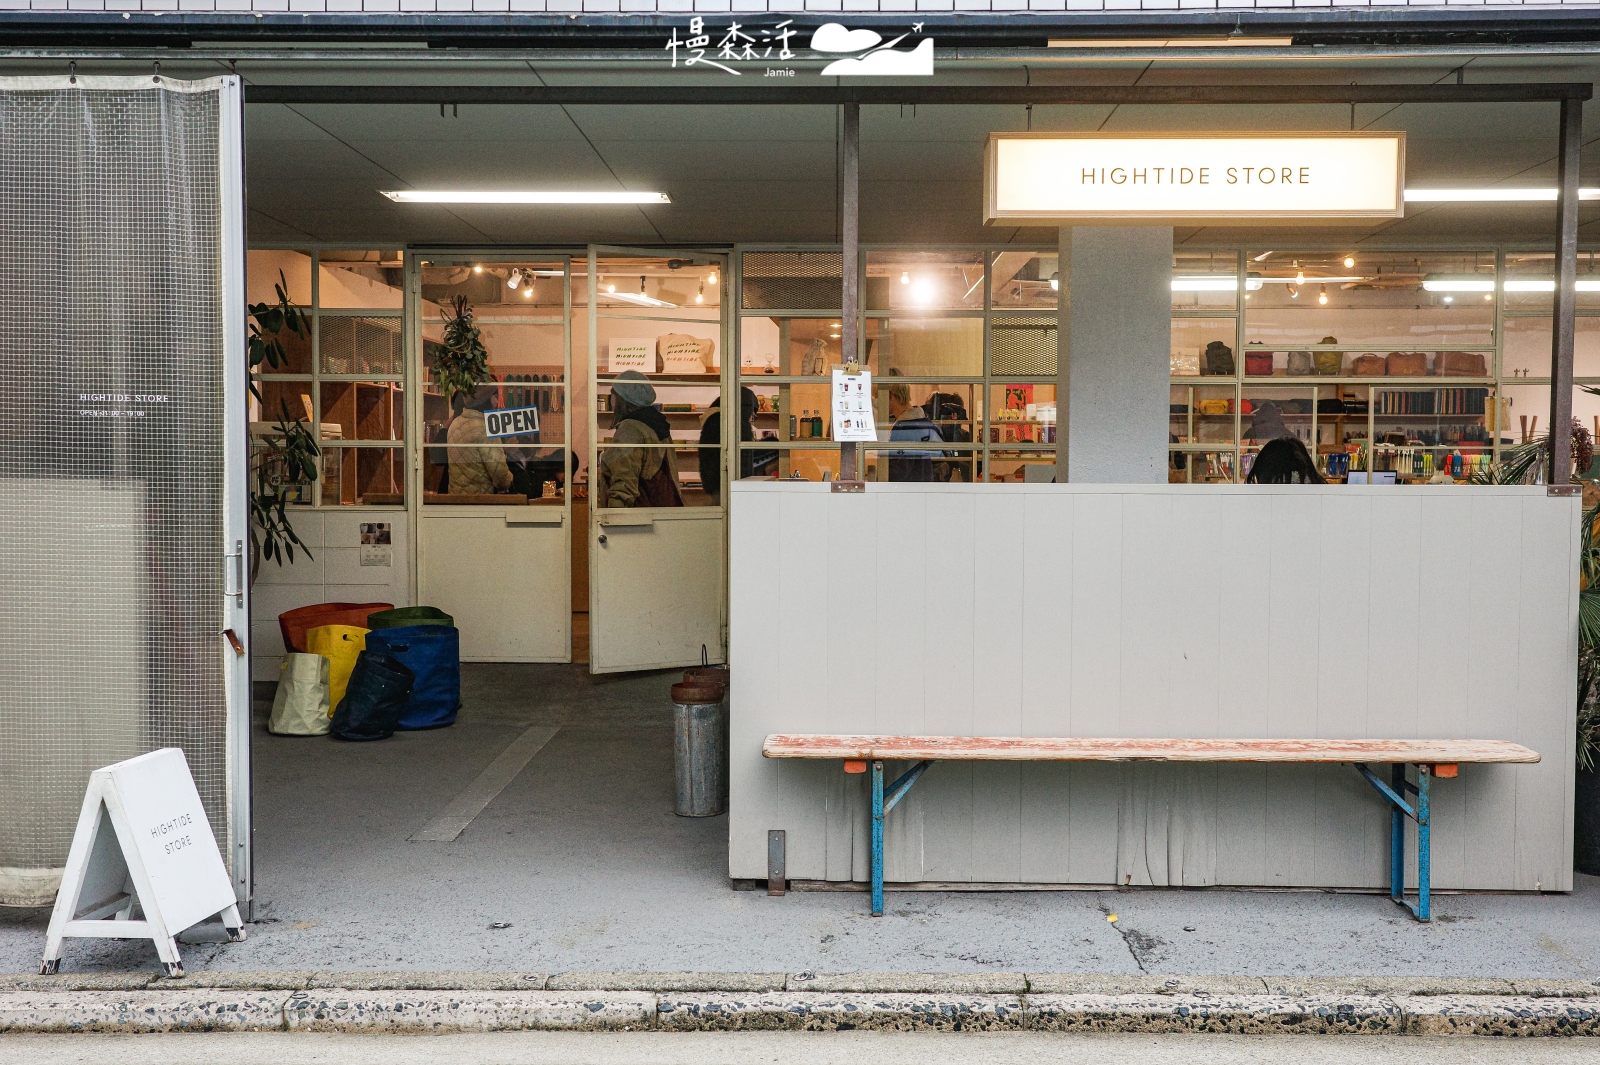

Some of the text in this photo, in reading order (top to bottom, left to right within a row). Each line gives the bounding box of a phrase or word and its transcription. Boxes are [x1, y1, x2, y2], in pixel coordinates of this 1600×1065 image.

[1081, 167, 1310, 185] HIGHTIDE STORE
[80, 394, 169, 403] HIGHTIDE STORE
[487, 409, 537, 435] OPEN
[150, 813, 193, 839] HIGHTIDE
[164, 835, 192, 855] STORE
